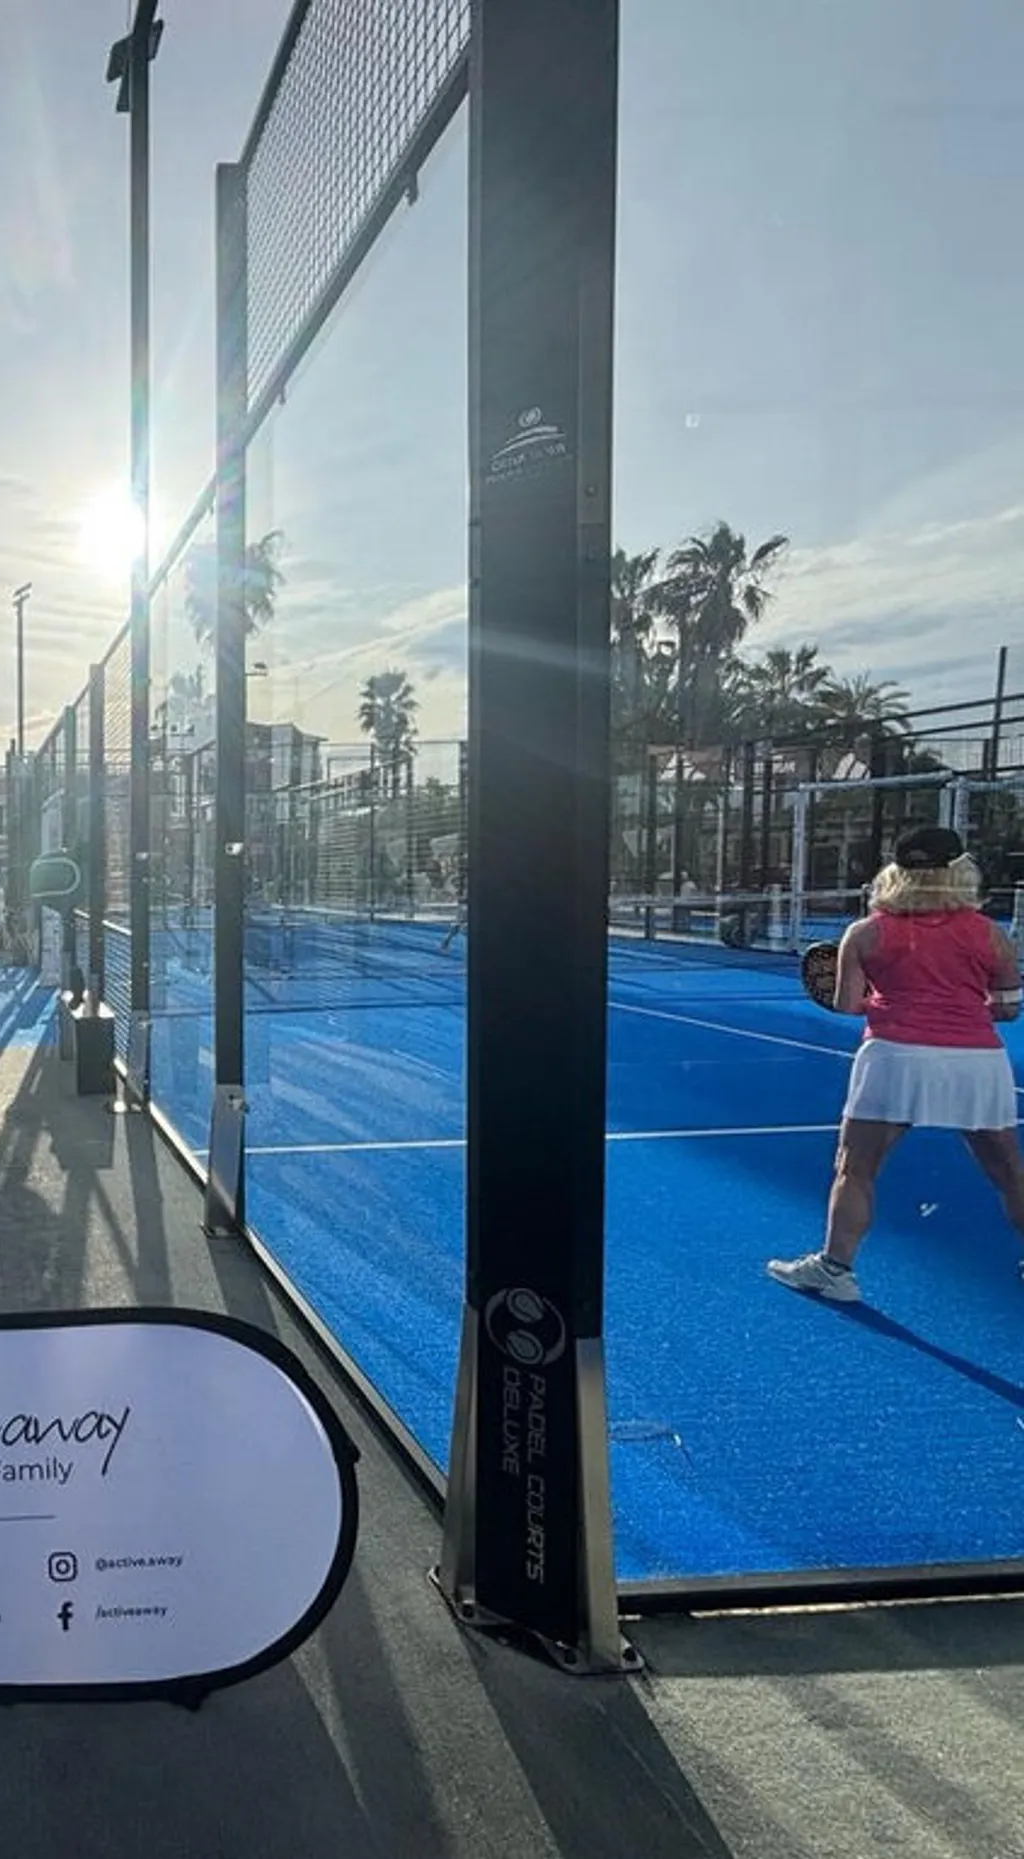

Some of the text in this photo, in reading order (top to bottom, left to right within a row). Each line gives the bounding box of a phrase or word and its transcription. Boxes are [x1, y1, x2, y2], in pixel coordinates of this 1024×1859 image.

[502, 1365, 521, 1478] DELUXE
[525, 1371, 547, 1585] PADEL COURTS
